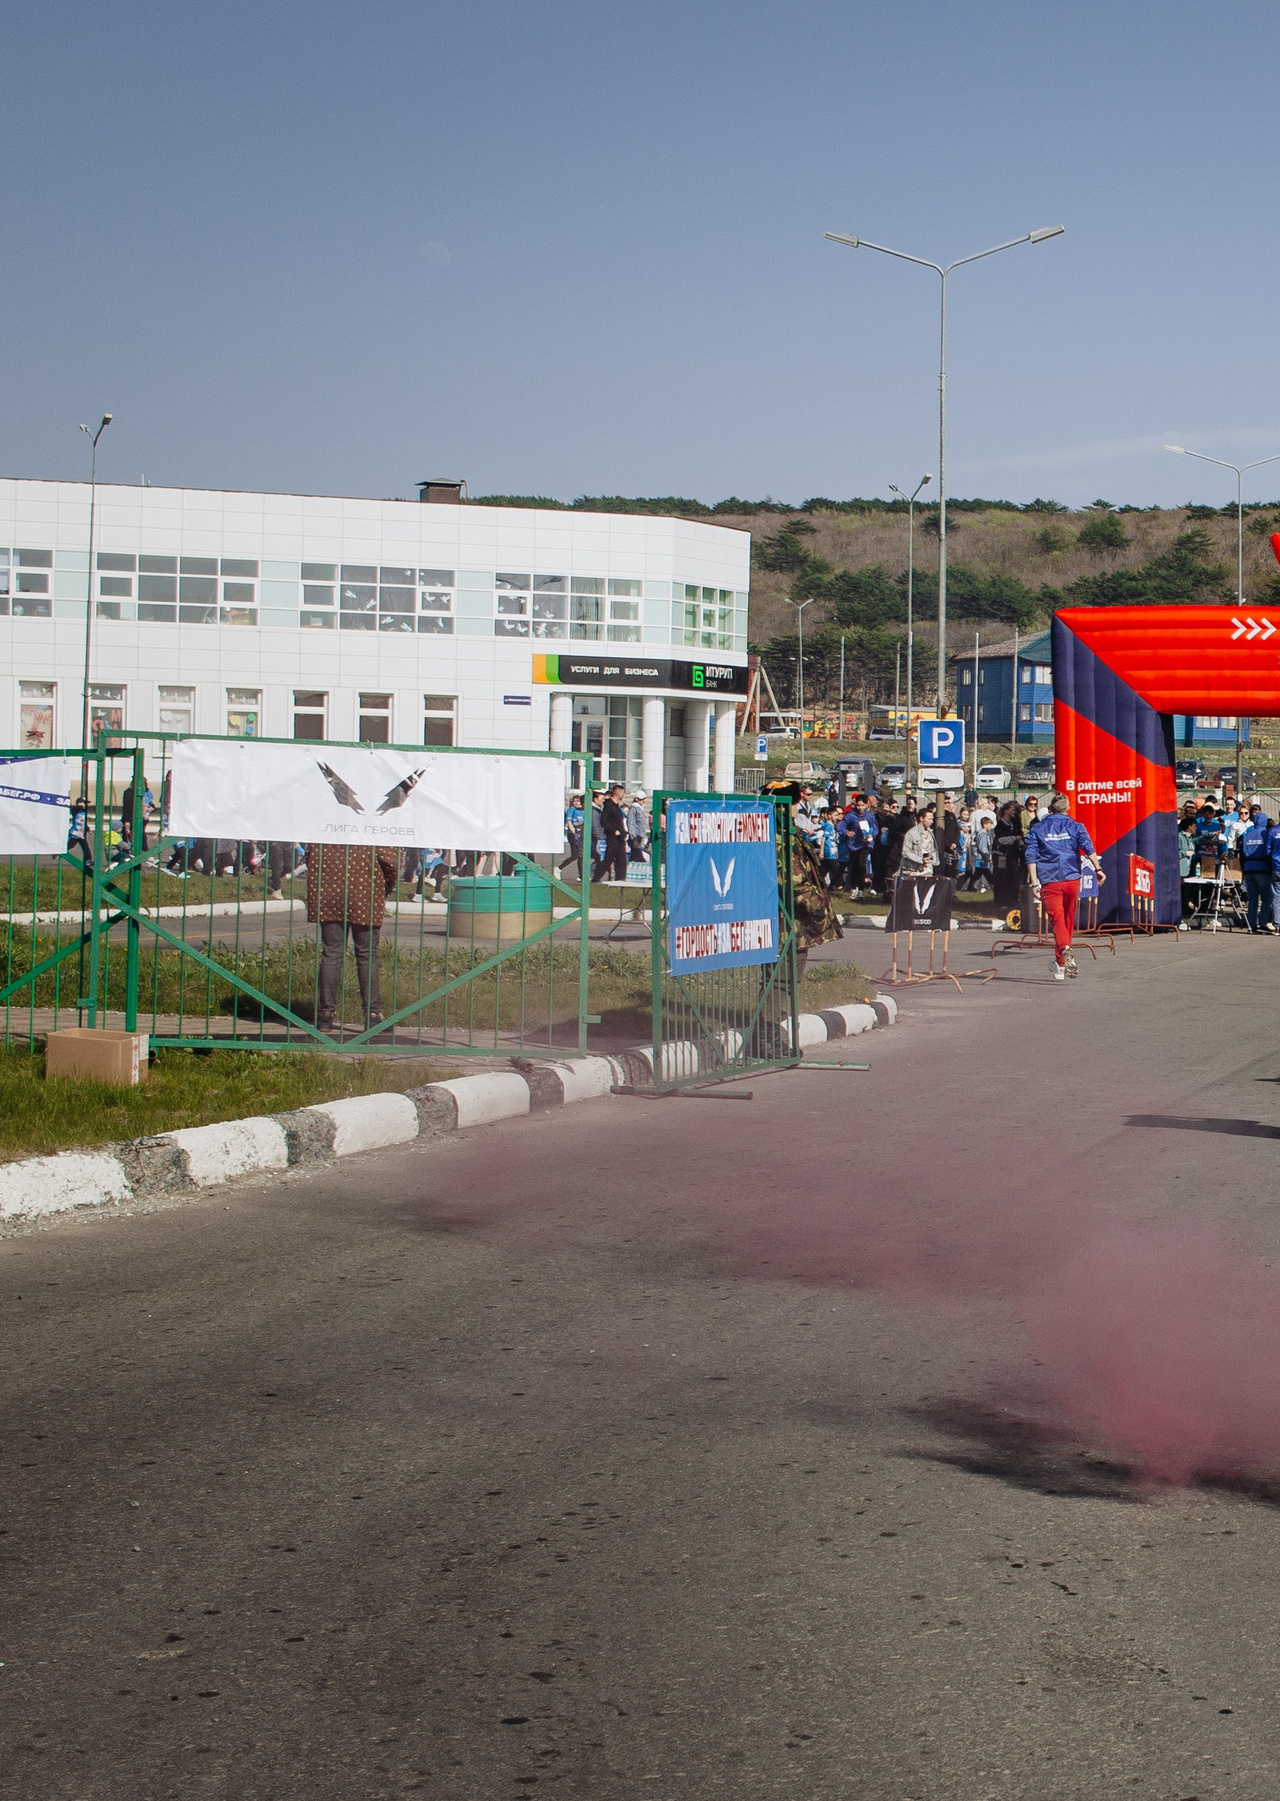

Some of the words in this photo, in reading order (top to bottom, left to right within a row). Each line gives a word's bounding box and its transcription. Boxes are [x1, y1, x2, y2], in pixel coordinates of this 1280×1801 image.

[571, 665, 600, 674] УСЛУГИ
[604, 667, 620, 675] ДЛЯ
[625, 668, 659, 676] БИЗНЕСА
[706, 665, 733, 679] ИТУРУП
[932, 727, 955, 759] P
[1066, 780, 1075, 791] В
[1077, 781, 1114, 792] ритме
[1116, 777, 1142, 789] всей
[1077, 792, 1132, 804] СТРАНЫ!
[323, 823, 360, 833] ЛИГА
[364, 825, 416, 837] ГЕРОЕВ
